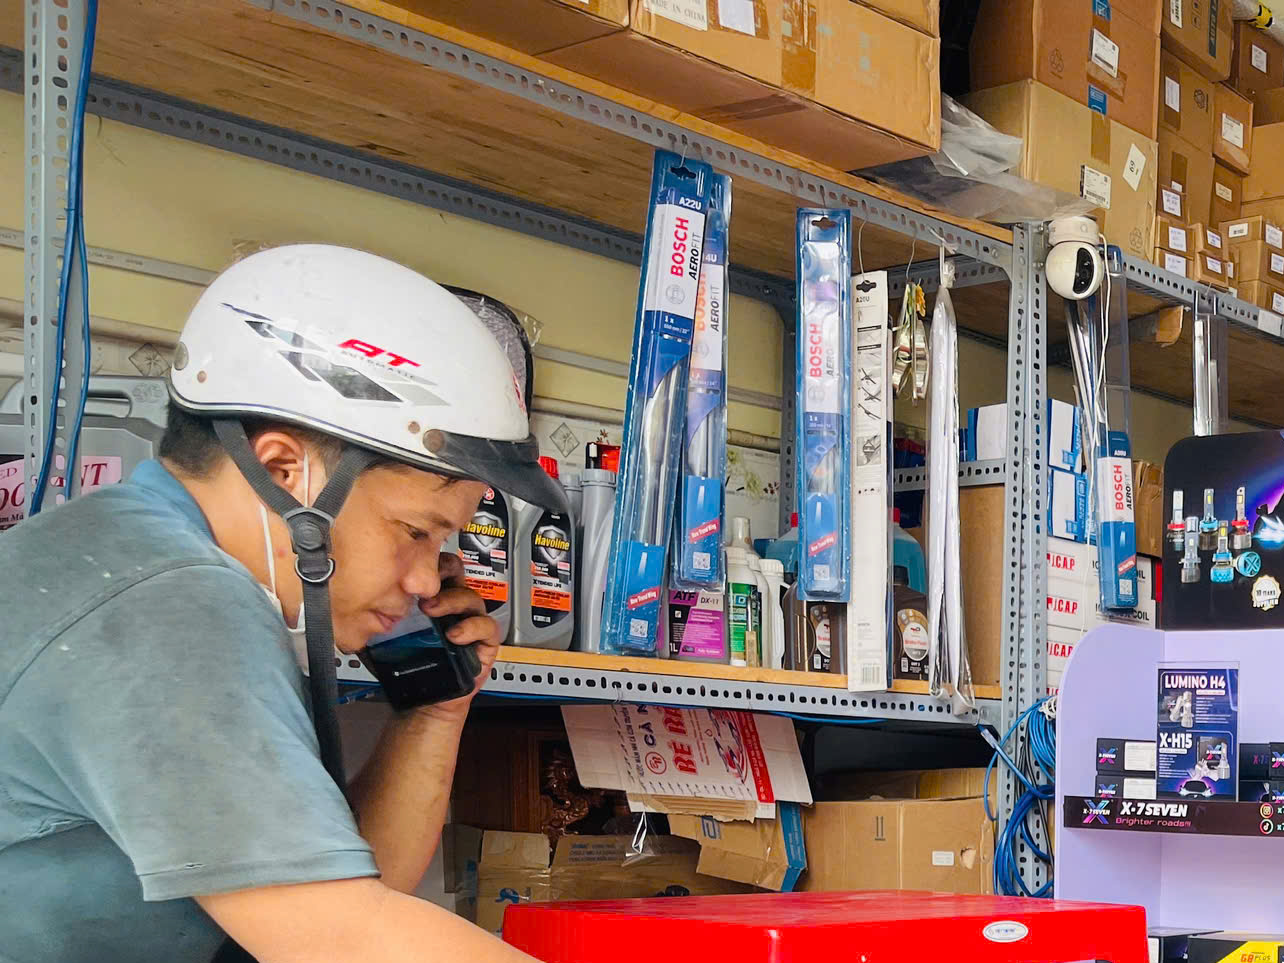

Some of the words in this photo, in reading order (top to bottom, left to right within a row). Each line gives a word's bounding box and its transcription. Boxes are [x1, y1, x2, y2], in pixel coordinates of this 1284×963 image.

[679, 196, 702, 210] A22U
[671, 217, 690, 277] BOSCH
[689, 232, 703, 280] AEROFIT
[710, 285, 722, 332] AEROFIT
[810, 323, 823, 378] BOSCH
[1113, 464, 1124, 511] BOSCH
[535, 534, 570, 551] Havoline
[674, 592, 697, 600] ATF
[1164, 675, 1208, 689] LUMINO
[1210, 675, 1226, 689] H4
[1115, 817, 1154, 827] Brighter
